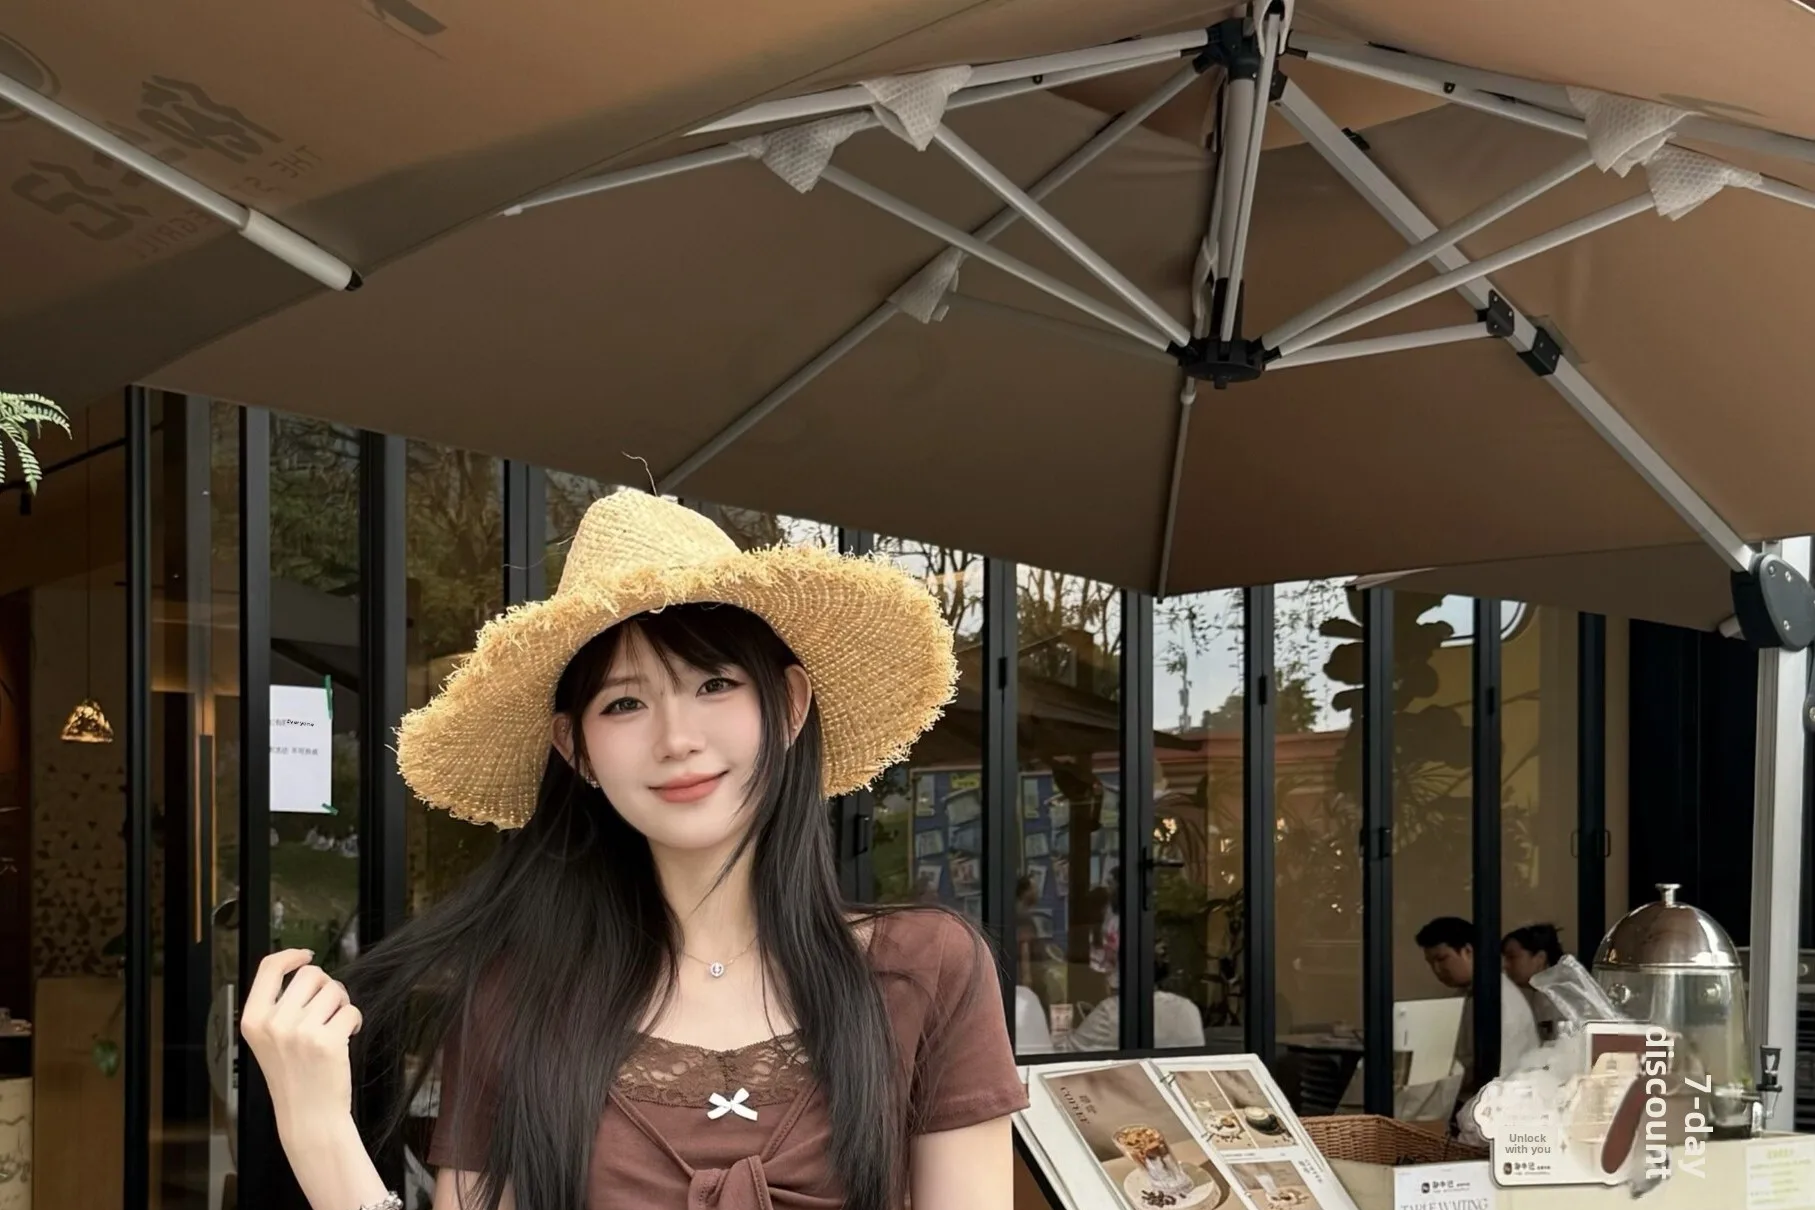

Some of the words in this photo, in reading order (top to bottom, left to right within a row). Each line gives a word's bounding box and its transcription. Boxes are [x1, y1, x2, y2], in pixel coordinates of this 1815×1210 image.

[1508, 1133, 1547, 1143] Unlock
[1504, 1143, 1528, 1154] with
[1530, 1146, 1551, 1156] you
